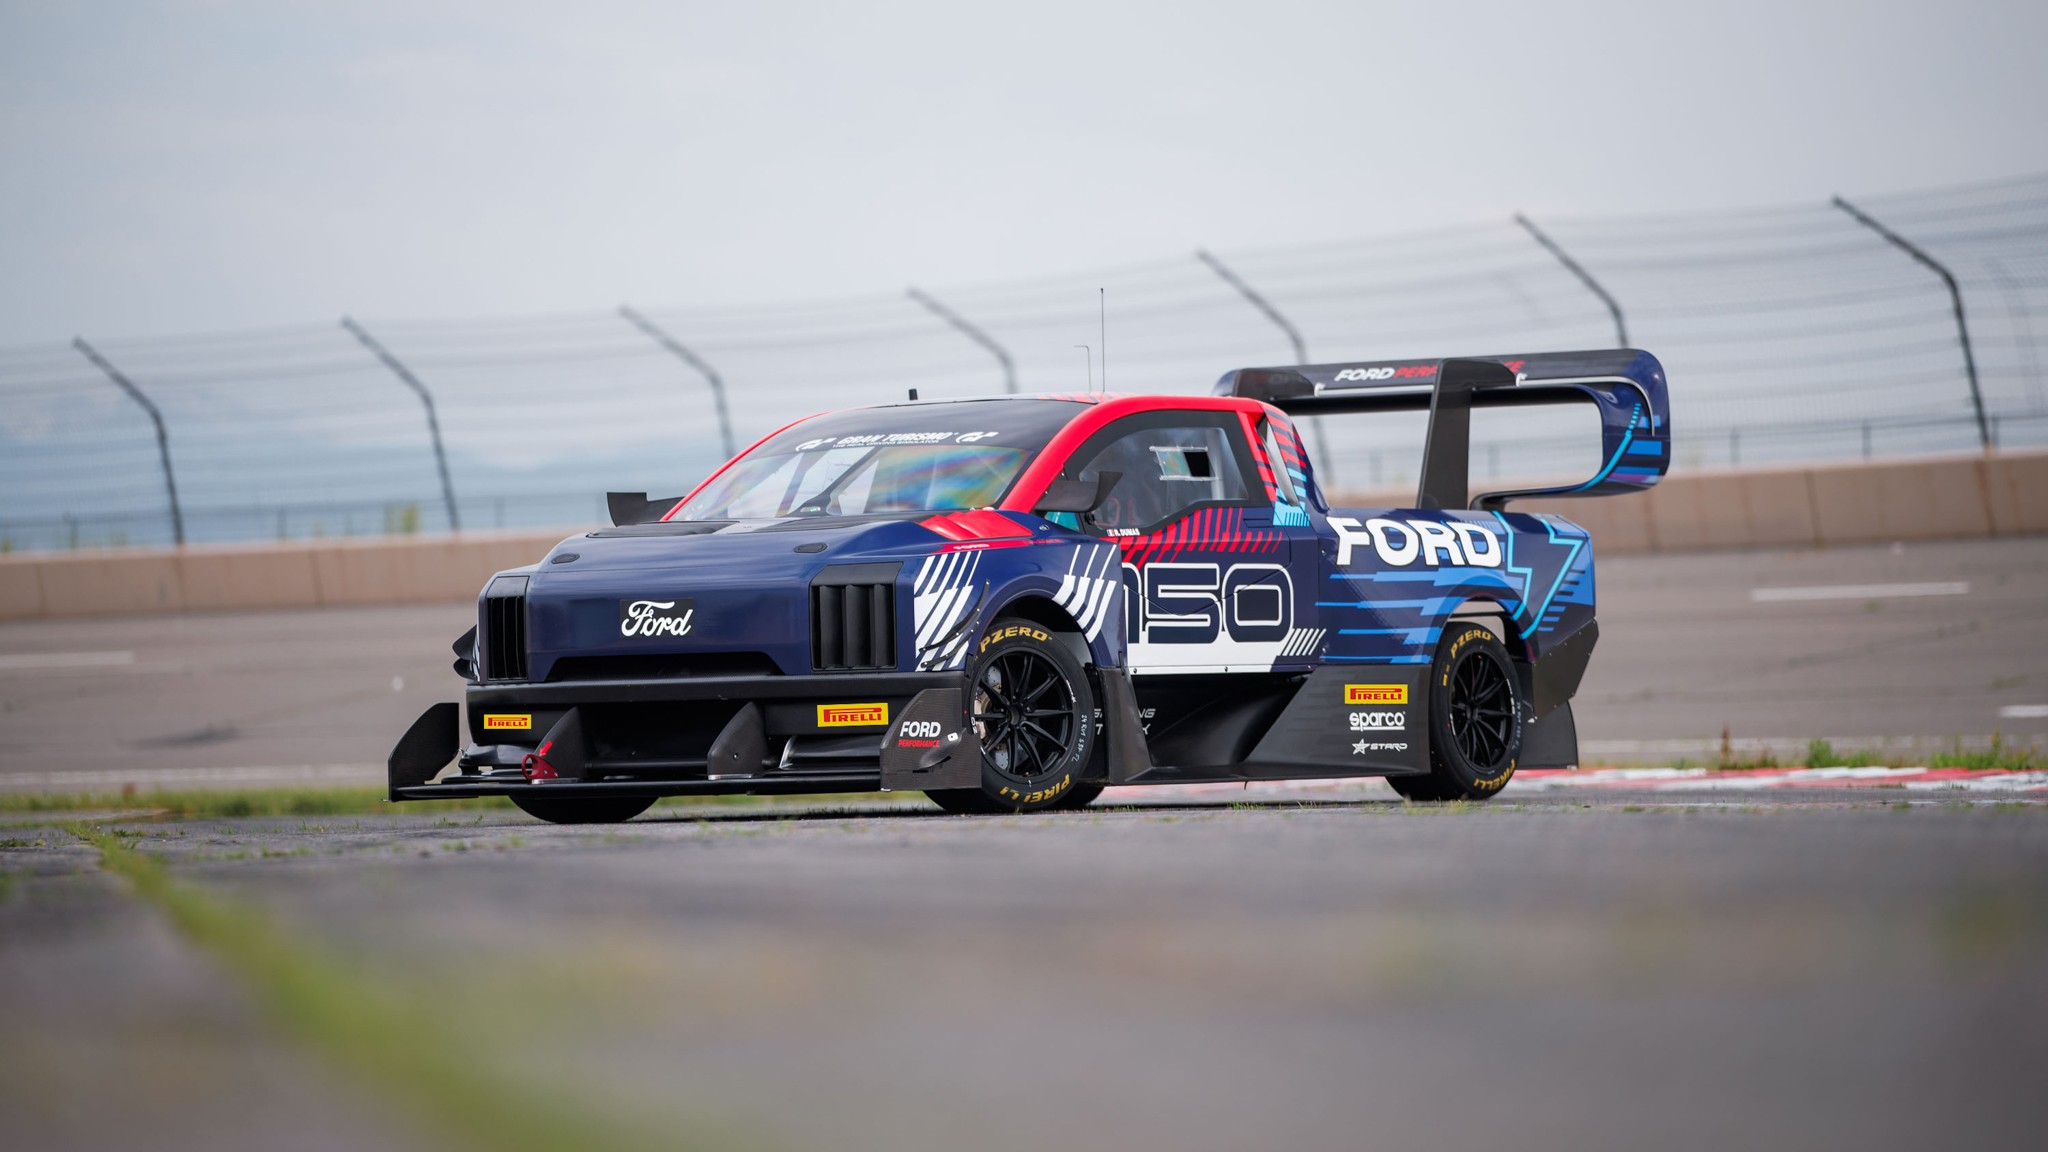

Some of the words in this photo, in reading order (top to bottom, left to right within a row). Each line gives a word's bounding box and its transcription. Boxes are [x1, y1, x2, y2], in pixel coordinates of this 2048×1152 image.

[1334, 367, 1395, 382] FORD
[1120, 528, 1140, 536] DUMAS
[1326, 516, 1502, 568] FORD
[621, 600, 693, 637] Ford
[1350, 688, 1402, 700] PIRELLI
[488, 717, 527, 726] PIRELLI
[823, 707, 882, 722] PIRELLI
[1349, 711, 1405, 732] sparco
[900, 721, 941, 737] FORD
[898, 739, 940, 748] PERFORMANCE
[1473, 758, 1515, 790] PIRELLI
